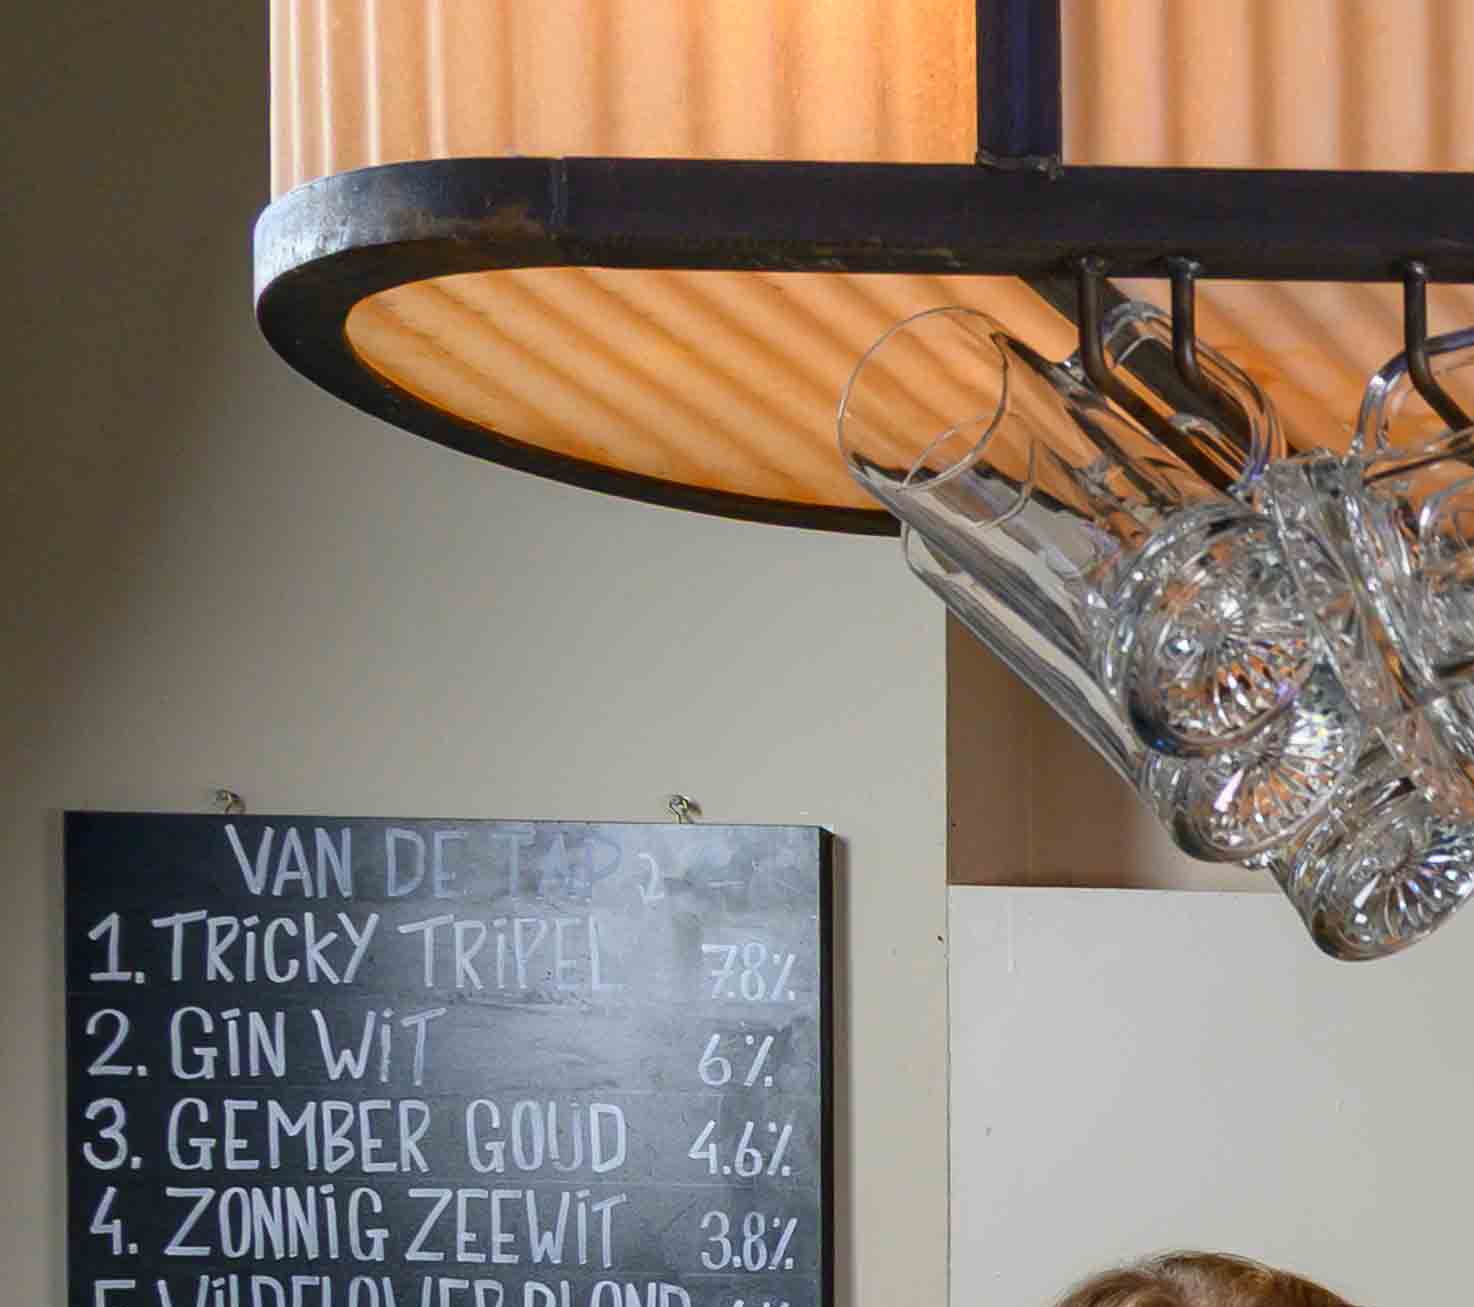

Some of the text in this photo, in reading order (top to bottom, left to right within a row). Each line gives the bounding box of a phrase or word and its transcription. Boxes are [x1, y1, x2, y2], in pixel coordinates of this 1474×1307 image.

[225, 824, 352, 898] VAN
[385, 828, 468, 898] DE
[88, 912, 145, 984] 1.
[151, 910, 379, 984] TRICKY
[398, 913, 623, 990] TRIPEL
[86, 1006, 774, 1087] 2. GIN WIT 6%
[83, 1098, 792, 1176] 3. GEMBER GOUD 4.6%
[90, 1184, 797, 1271] 4. ZONNIG ZEEWIT 3.8%
